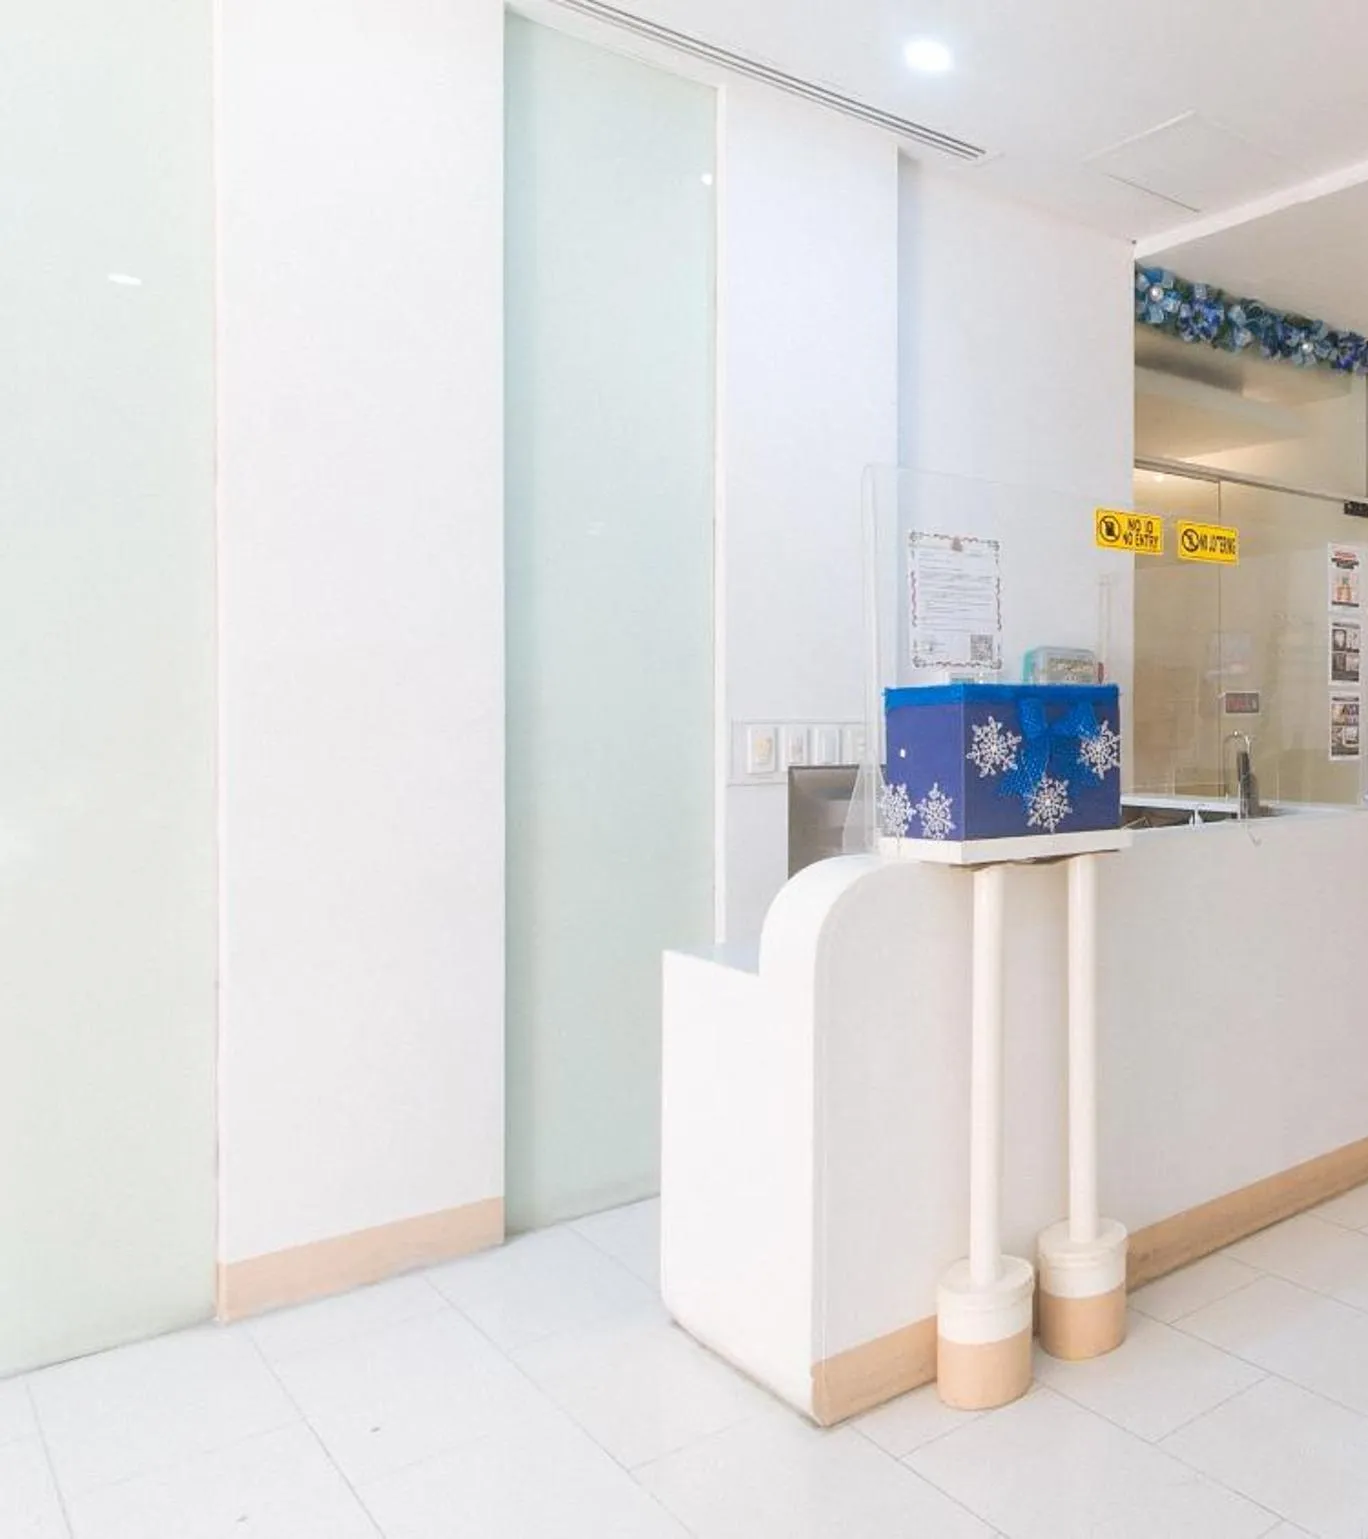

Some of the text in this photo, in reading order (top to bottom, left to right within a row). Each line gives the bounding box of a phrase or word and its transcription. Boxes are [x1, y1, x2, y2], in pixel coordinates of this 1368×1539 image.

[1127, 518, 1141, 531] NO
[1122, 531, 1159, 547] NO ENTRY
